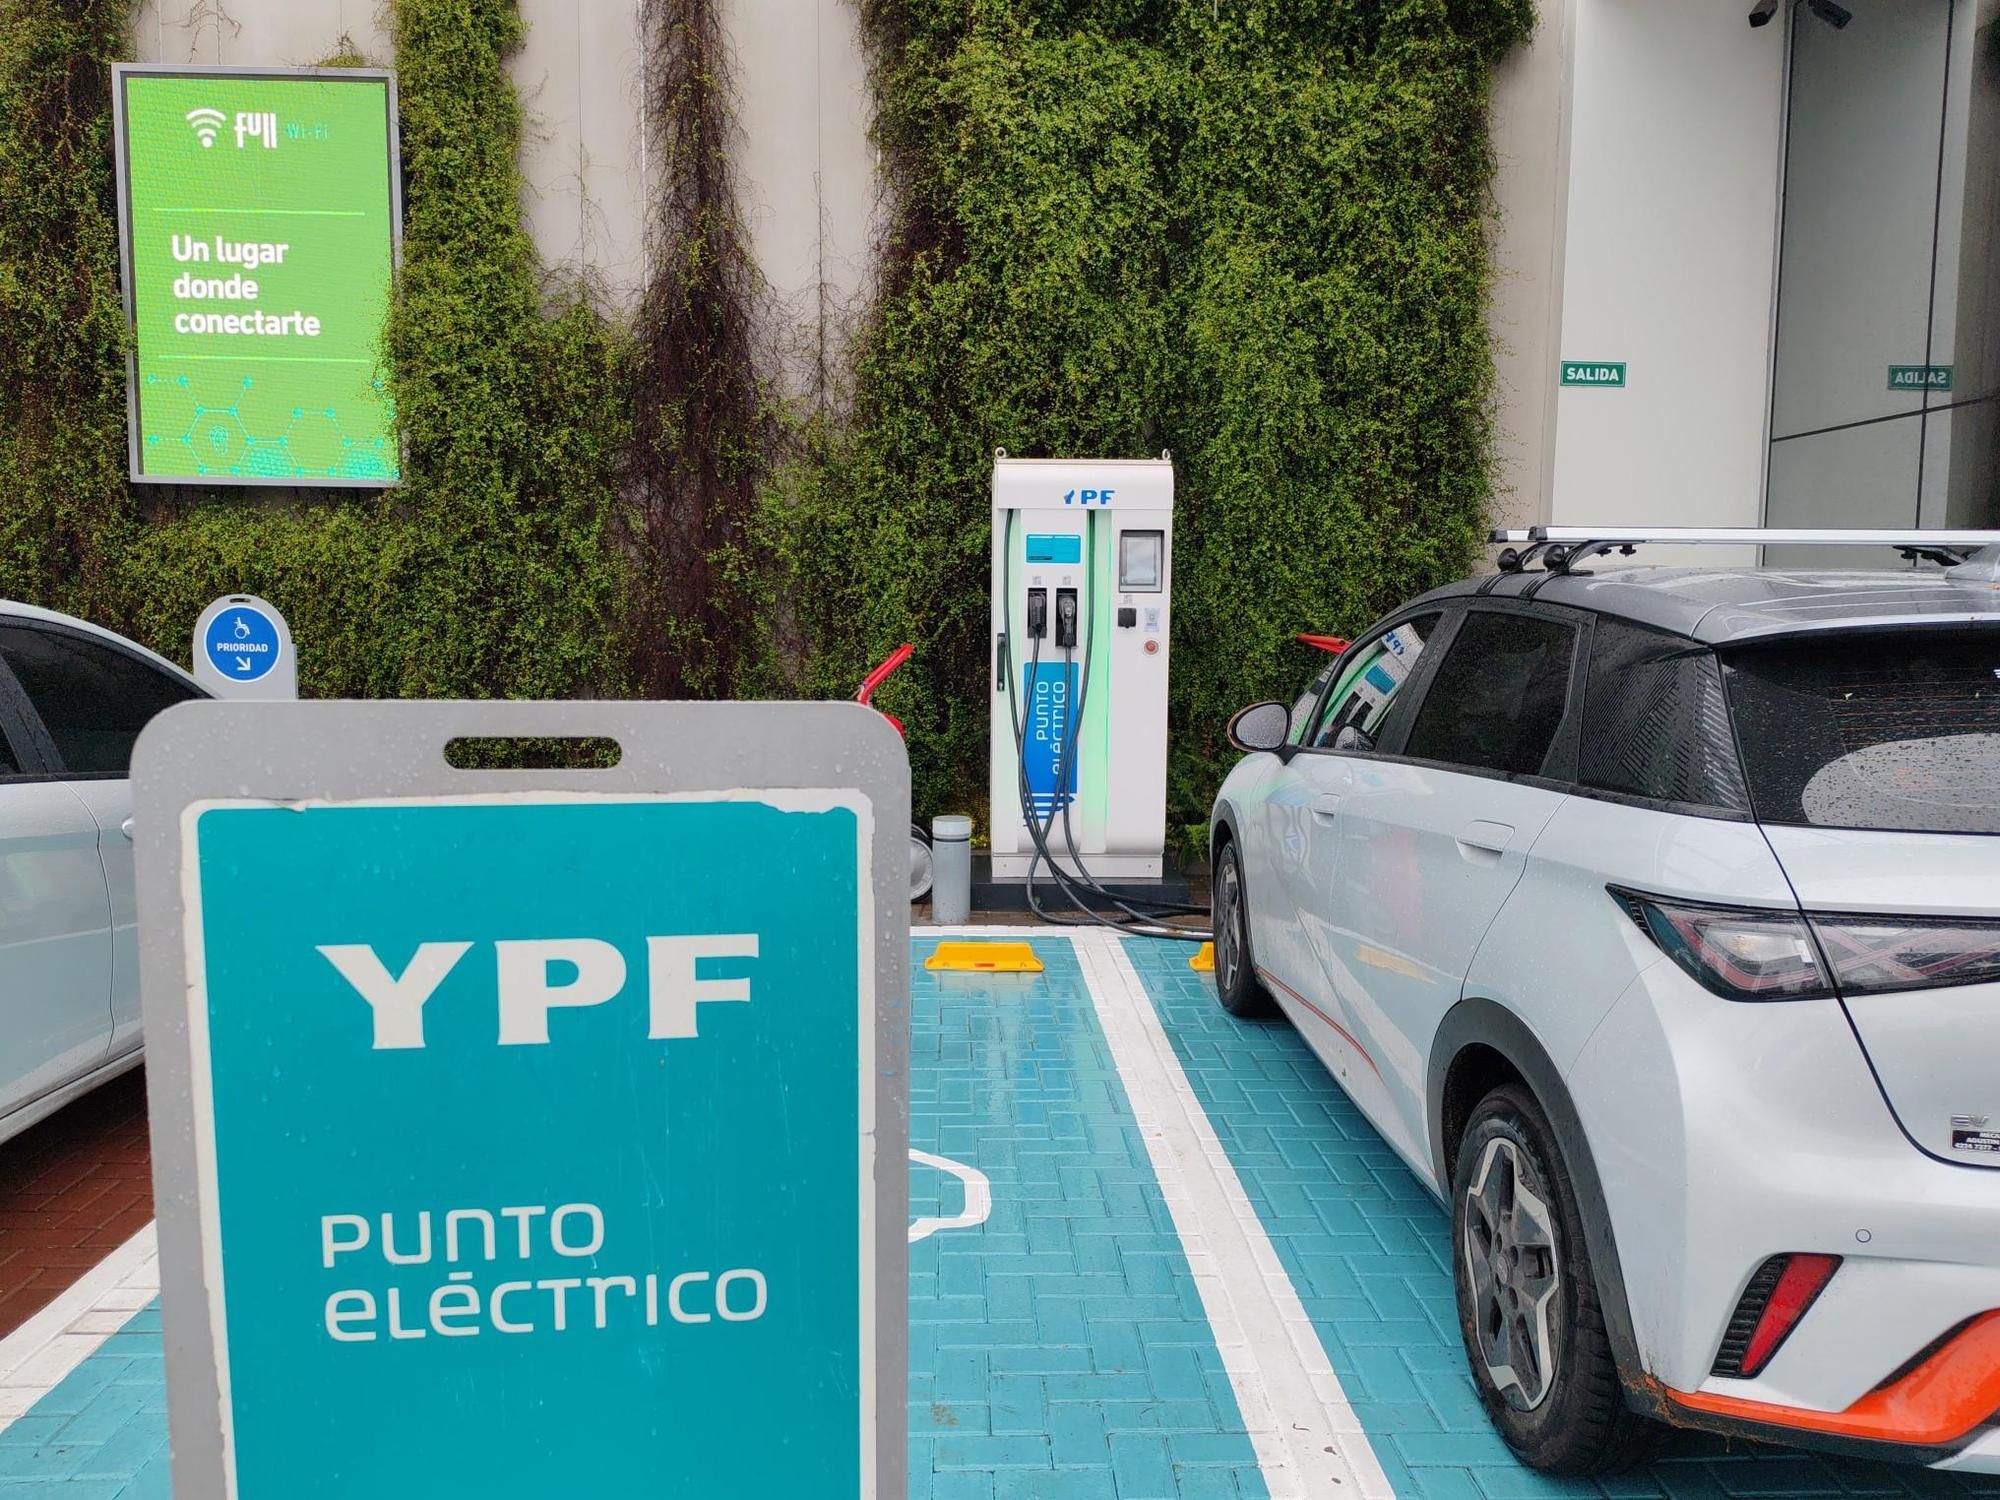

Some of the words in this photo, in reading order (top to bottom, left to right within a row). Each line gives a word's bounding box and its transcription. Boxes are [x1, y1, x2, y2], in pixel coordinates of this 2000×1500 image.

[233, 112, 278, 149] full
[171, 234, 210, 262] Un
[216, 235, 289, 269] lugar
[173, 272, 259, 300] donde
[175, 310, 321, 336] conectarte
[1566, 367, 1619, 381] SALIDA
[1063, 489, 1116, 505] YPF
[216, 643, 269, 653] PRIORIDAD
[315, 933, 760, 1050] YPF
[1951, 1114, 1989, 1128] EV
